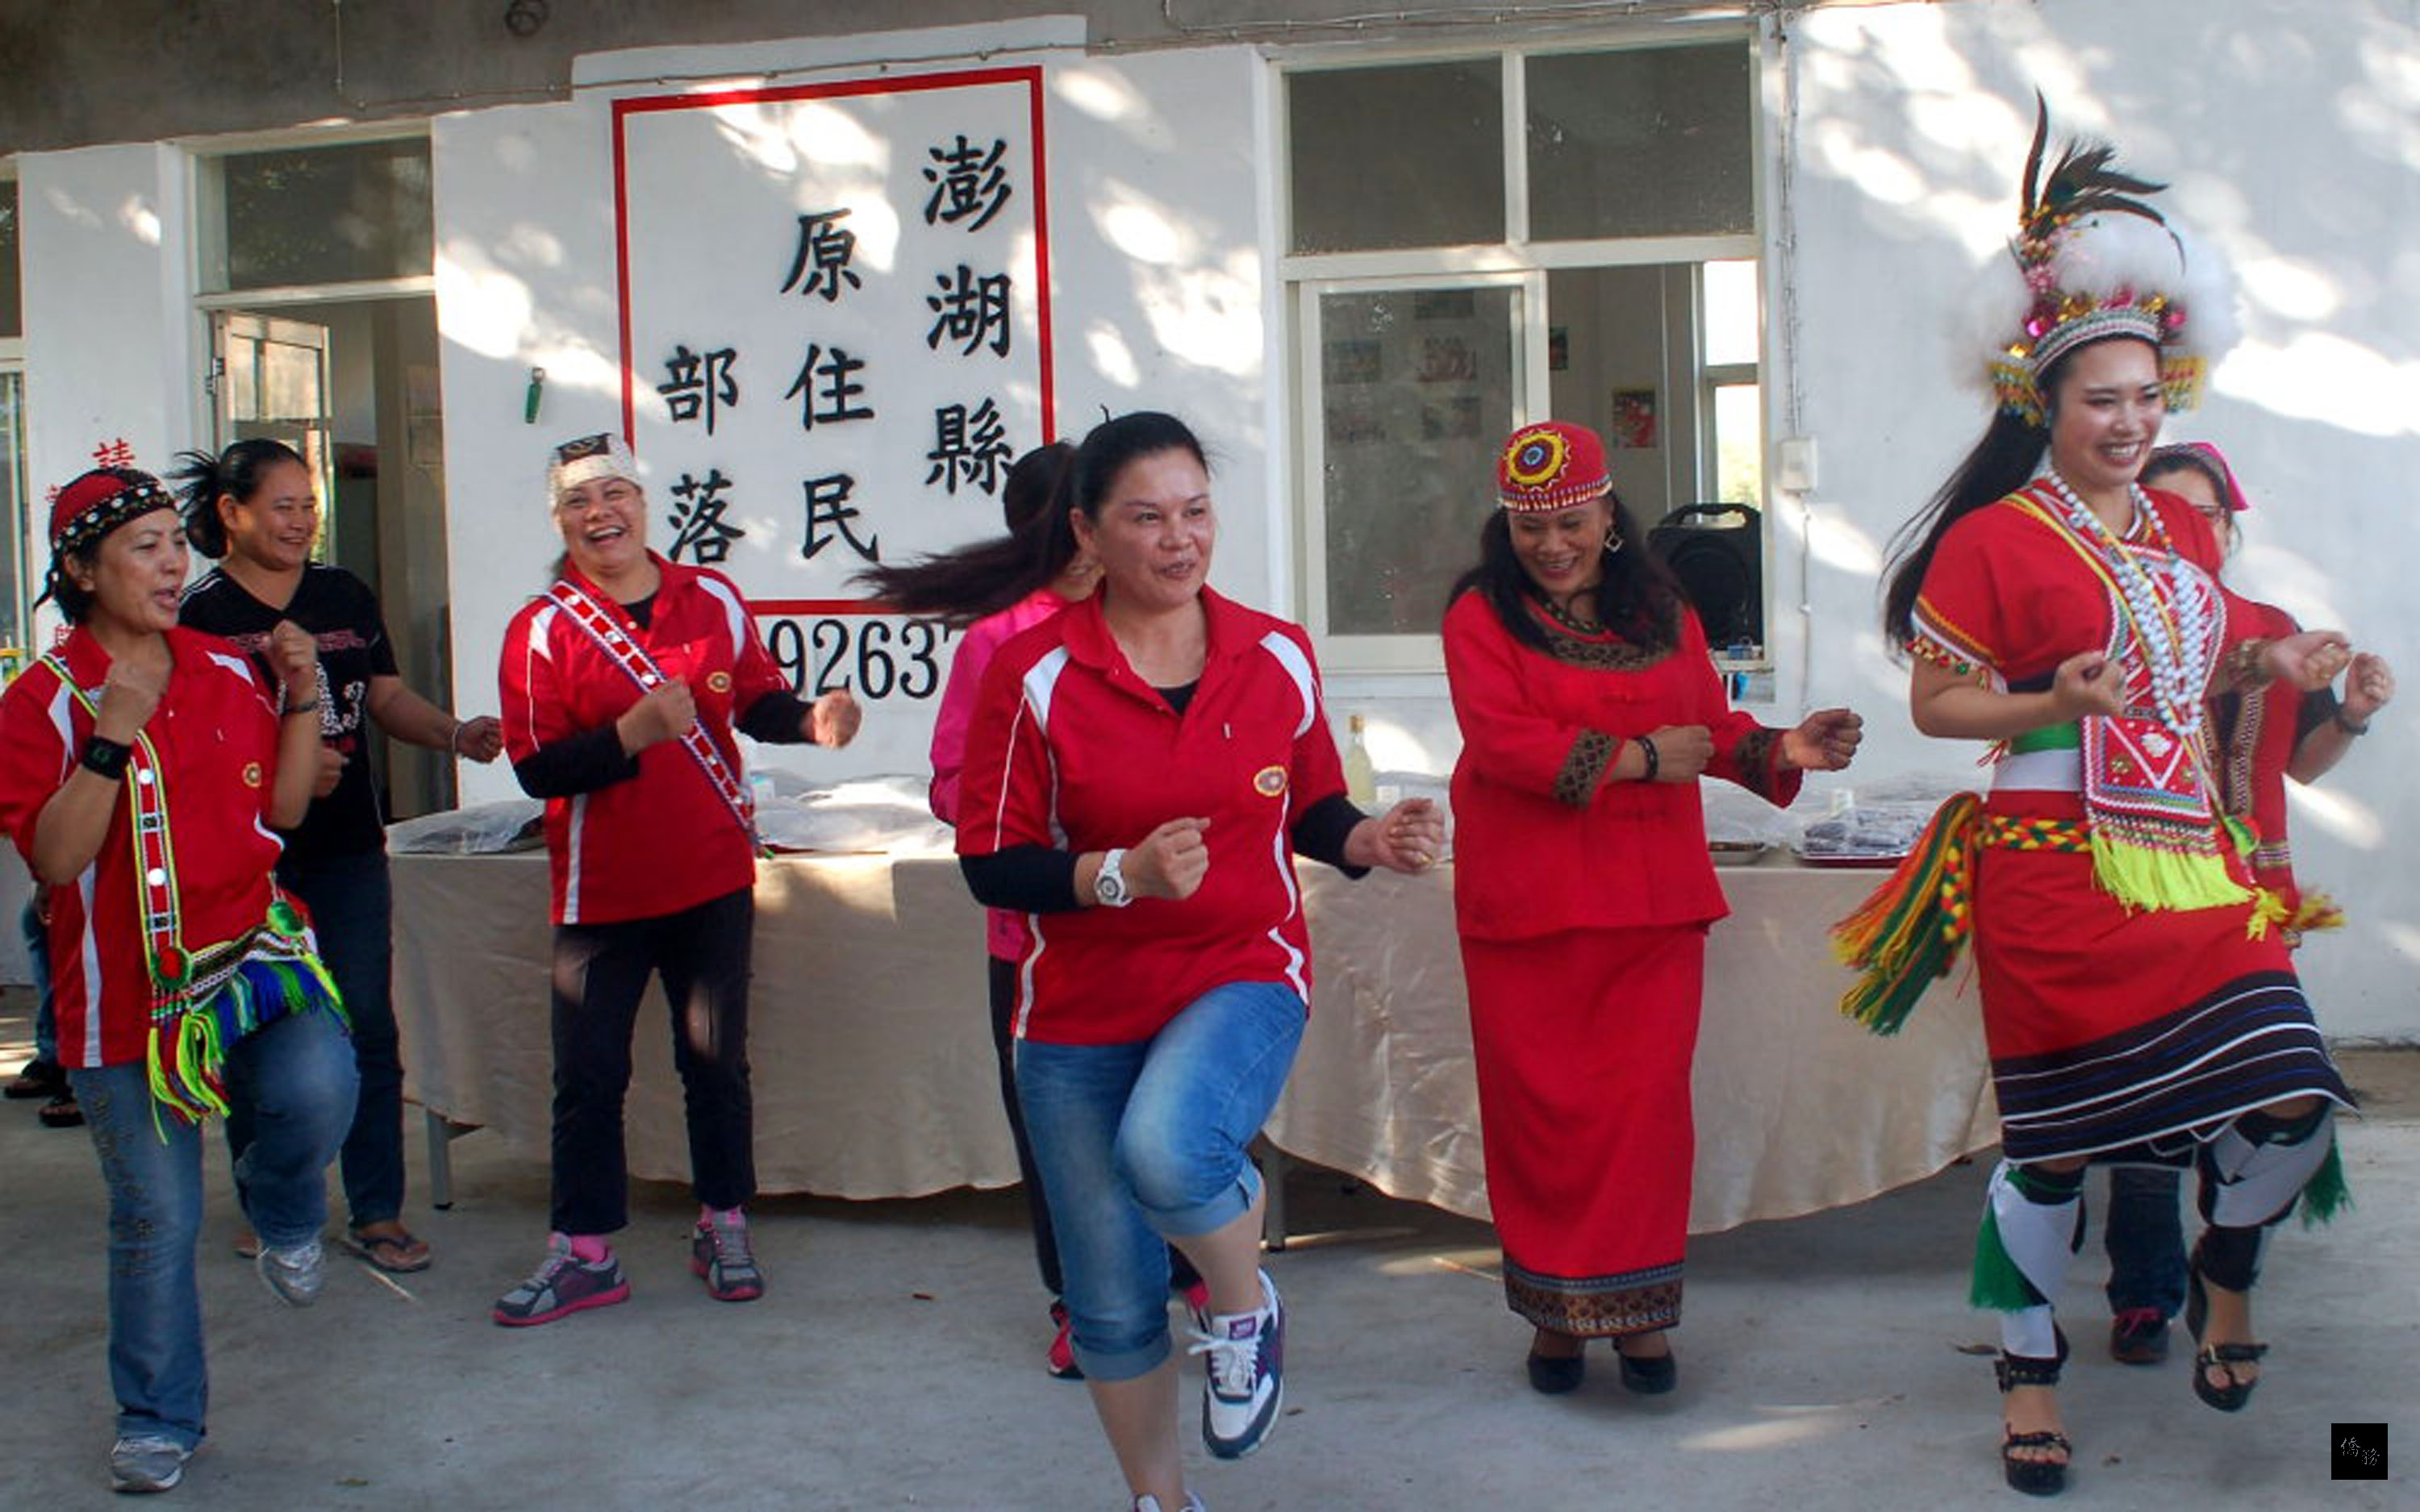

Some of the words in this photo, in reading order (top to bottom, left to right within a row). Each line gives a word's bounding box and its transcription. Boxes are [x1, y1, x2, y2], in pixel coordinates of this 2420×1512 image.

[656, 344, 745, 566] 部落
[780, 208, 878, 564] 原住民
[922, 135, 1014, 495] 澎湖縣
[769, 619, 950, 699] 9263
